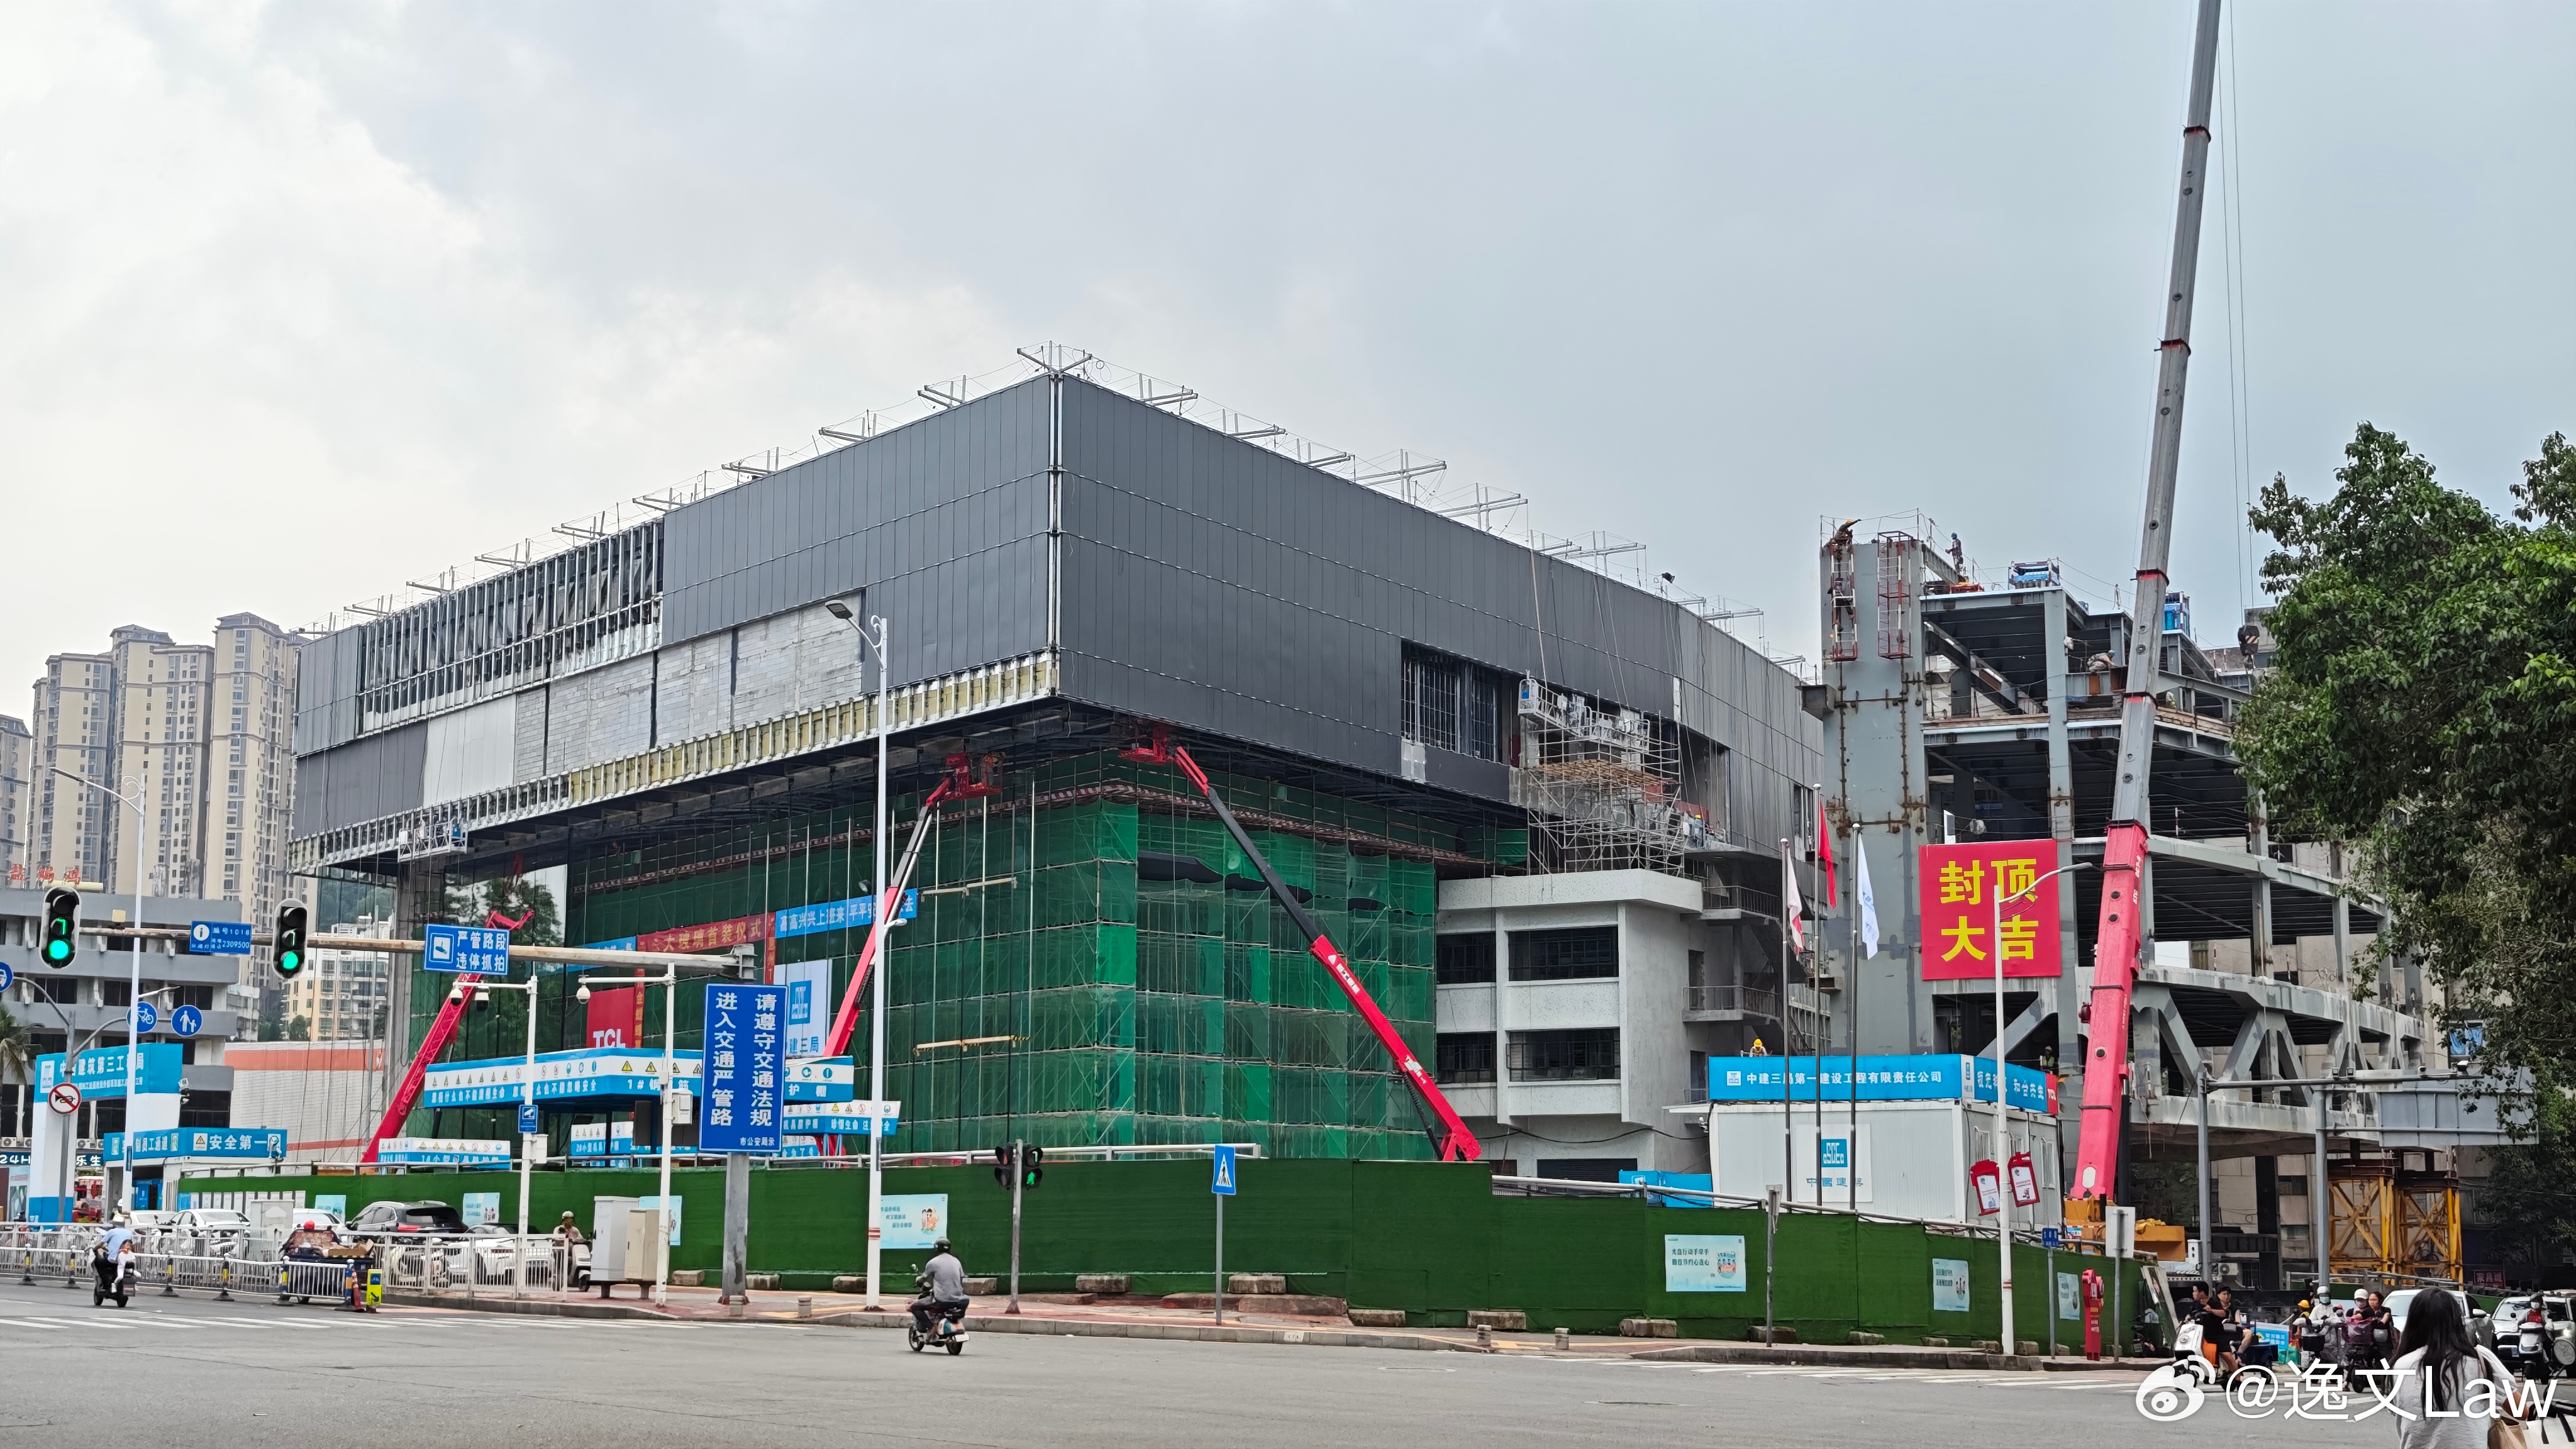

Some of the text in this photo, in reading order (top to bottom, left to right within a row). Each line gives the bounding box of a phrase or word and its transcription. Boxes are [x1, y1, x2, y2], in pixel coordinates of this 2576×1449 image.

[1940, 858, 2039, 905] 封顶
[780, 906, 845, 933] 高高兴兴上班来
[457, 931, 506, 950] 严管路段
[1941, 914, 2039, 962] 大吉
[456, 952, 505, 972] 违停抓拍
[593, 1028, 626, 1048] TCL
[786, 1036, 819, 1055] 建三局
[60, 1052, 144, 1077] 中建筑第三工局
[710, 992, 738, 1127] 进入交通严管路
[750, 993, 777, 1127] 请遵守交通法规
[1746, 1070, 1941, 1085] 中建三局第一建设工程有限责任公司
[209, 1134, 267, 1150] 安全第一
[0, 1155, 31, 1164] 24H
[75, 1155, 101, 1167] 乐生
[1806, 1177, 1864, 1188] 中国建筑
